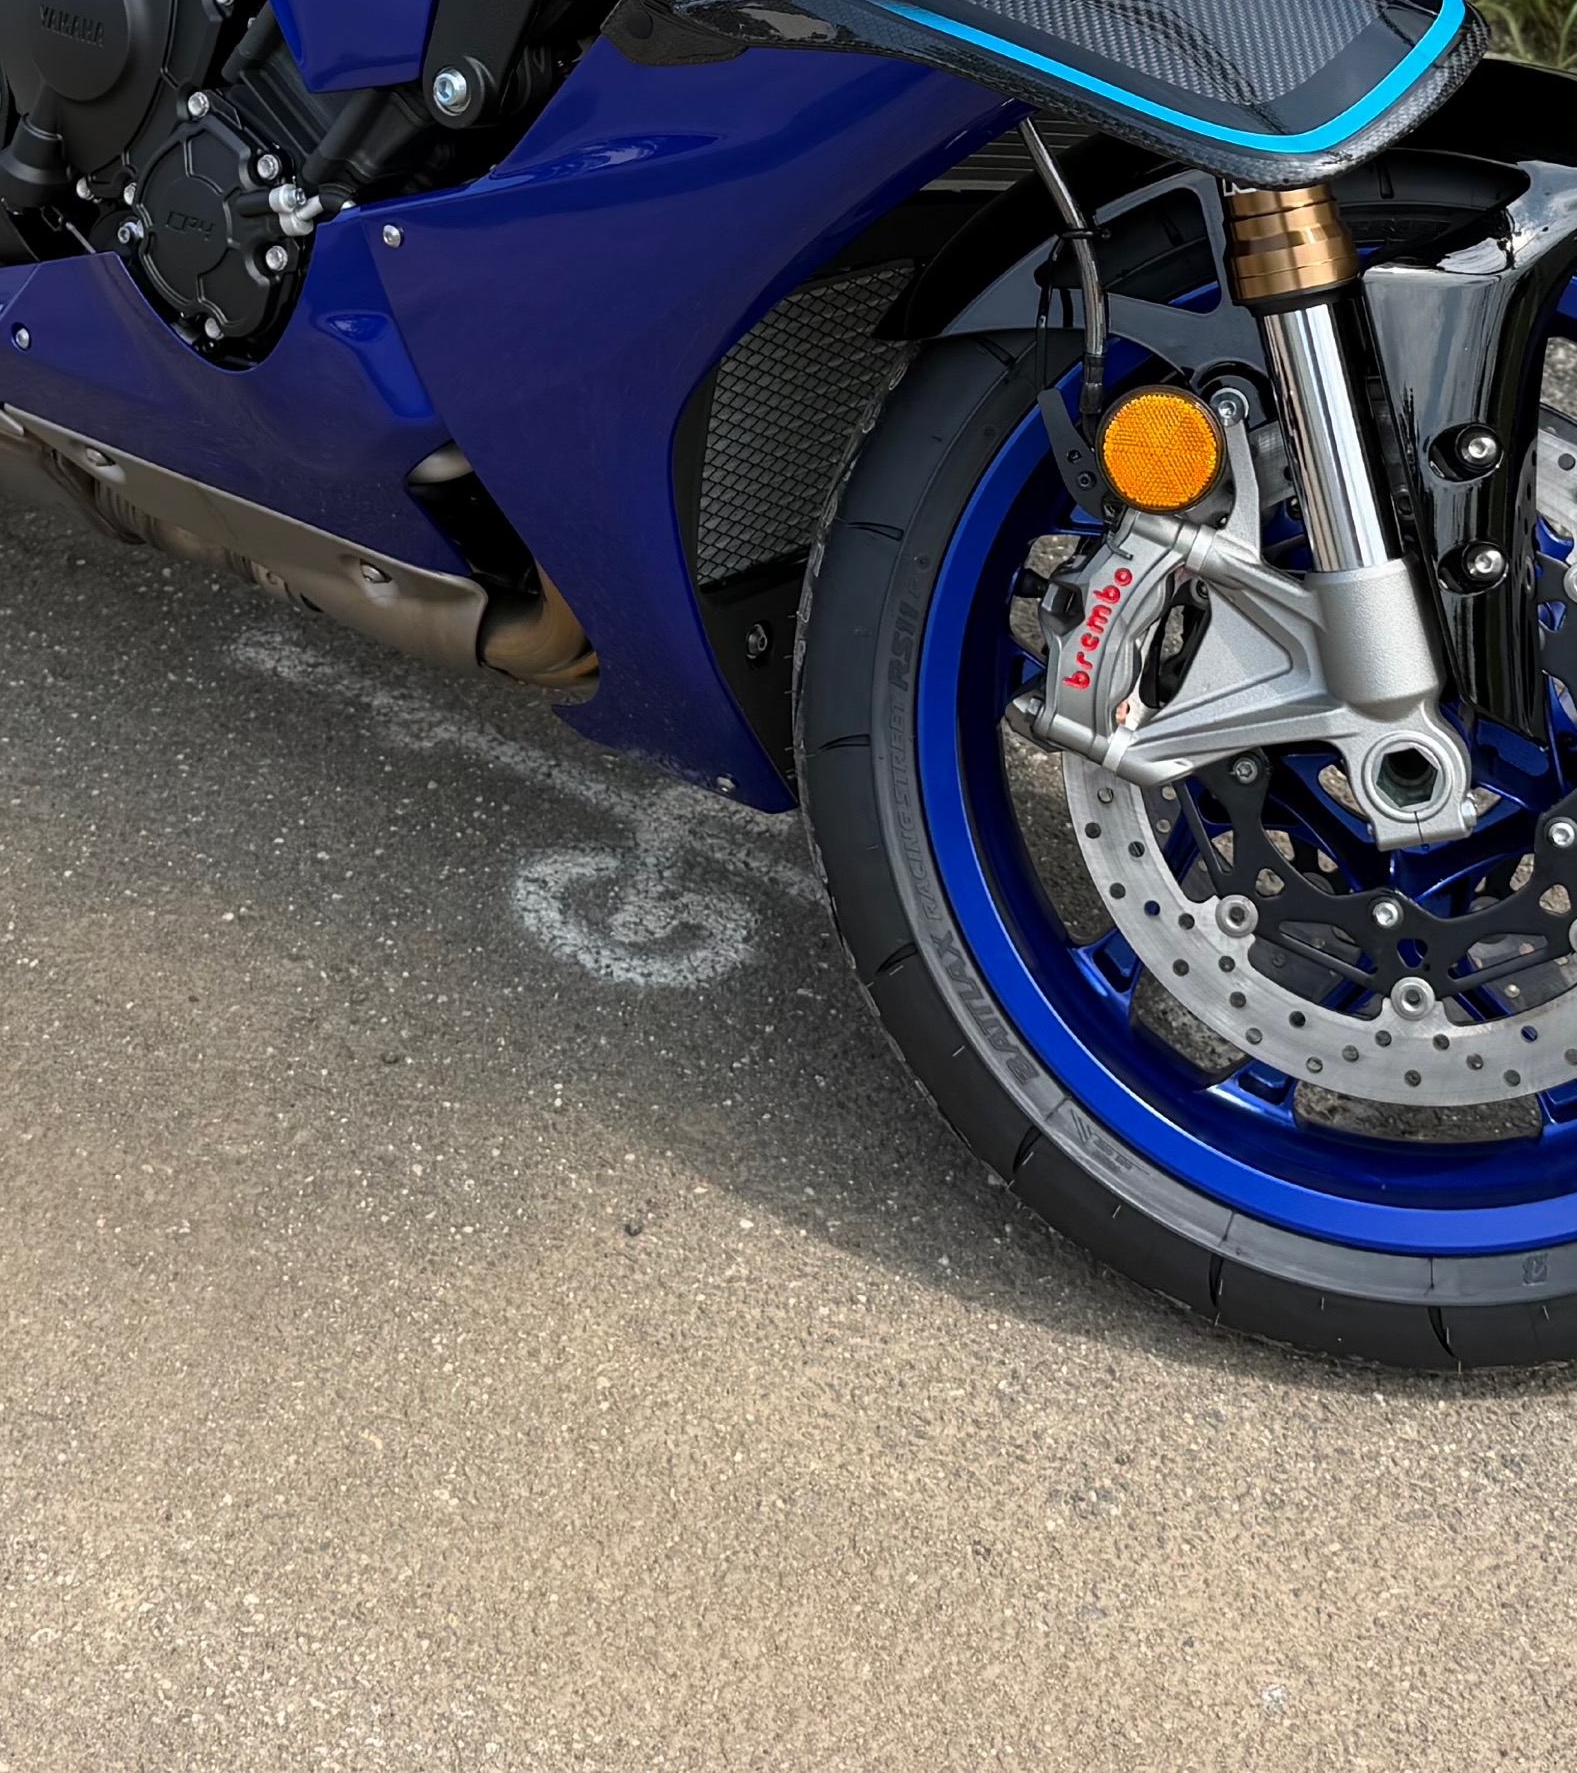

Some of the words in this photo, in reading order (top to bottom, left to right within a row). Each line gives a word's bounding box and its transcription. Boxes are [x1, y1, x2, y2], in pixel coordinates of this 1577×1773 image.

[40, 5, 105, 48] YAMAHA
[1062, 567, 1133, 691] brembo
[930, 930, 1040, 1087] BATTLAX
